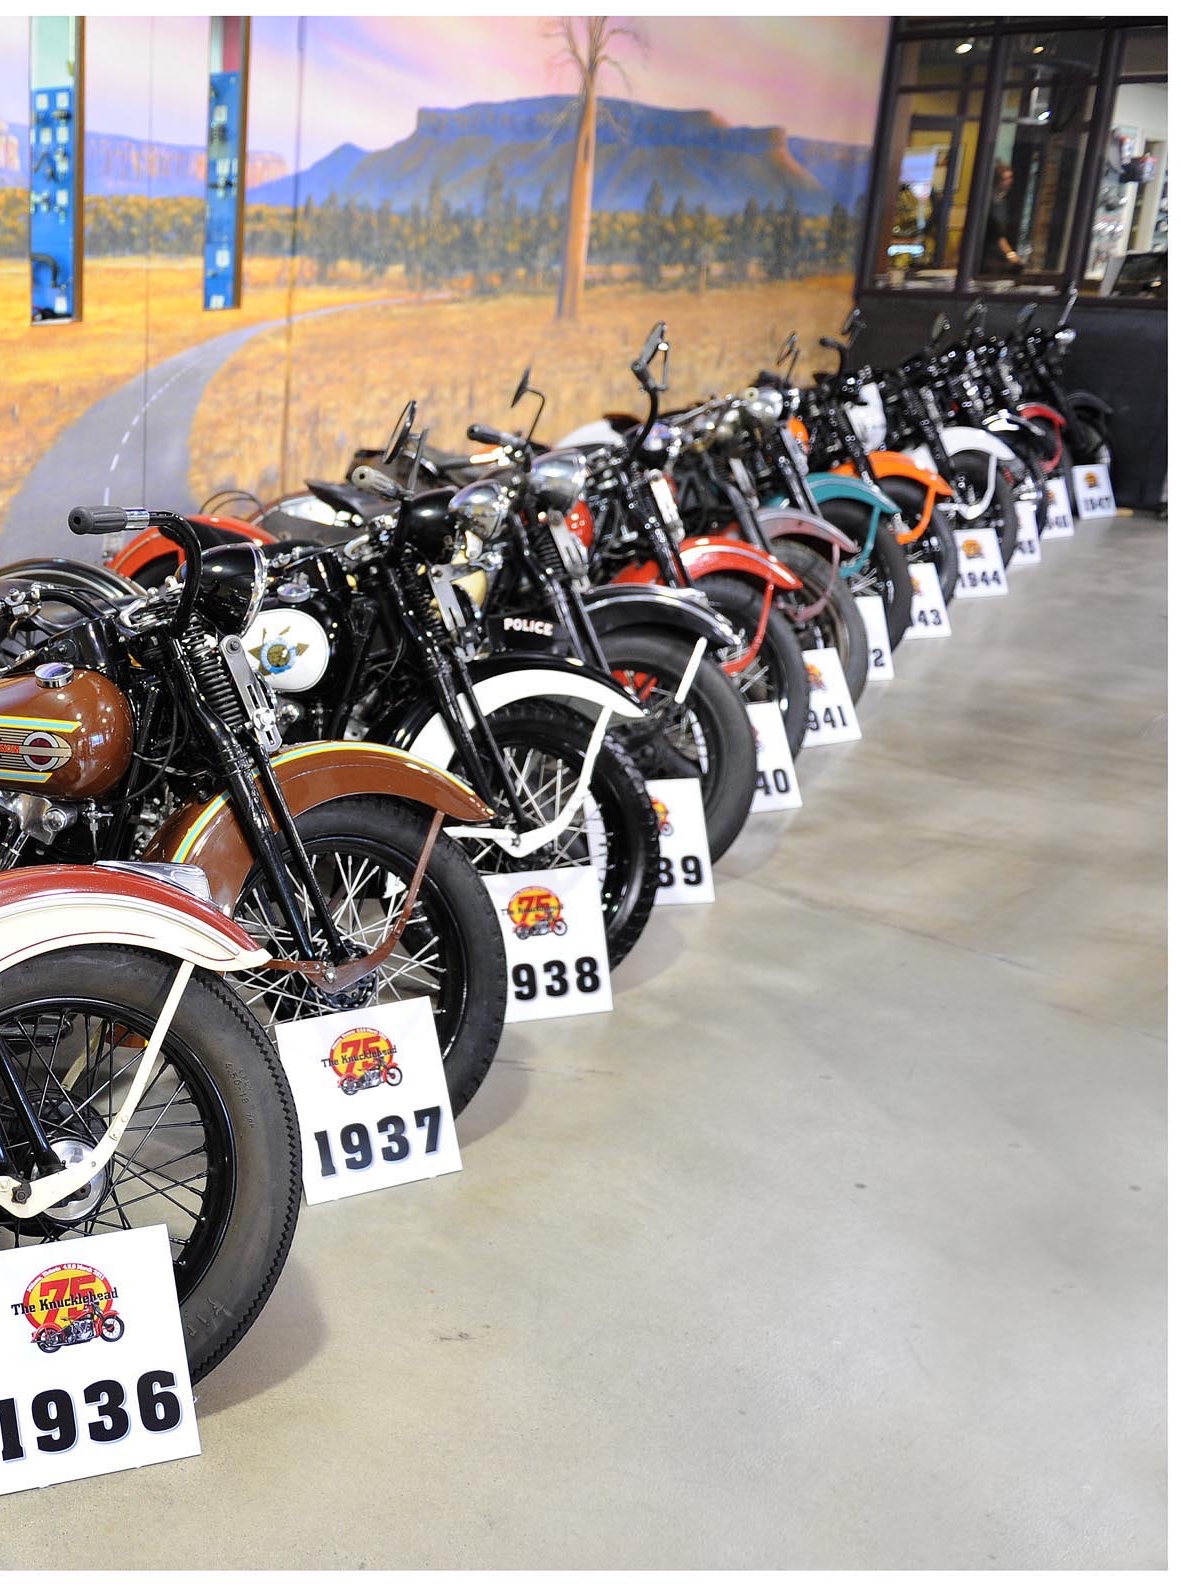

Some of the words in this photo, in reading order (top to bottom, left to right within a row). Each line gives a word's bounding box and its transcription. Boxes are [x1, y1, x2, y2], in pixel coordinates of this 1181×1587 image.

[503, 617, 554, 637] POLICE
[868, 648, 885, 668] 2
[321, 1057, 339, 1068] The
[340, 1044, 398, 1064] Knucklehead
[340, 1034, 382, 1074] 75
[313, 1104, 442, 1178] 1937
[10, 1302, 36, 1316] The
[38, 1287, 119, 1311] Knucklehead
[38, 1273, 97, 1325] 75
